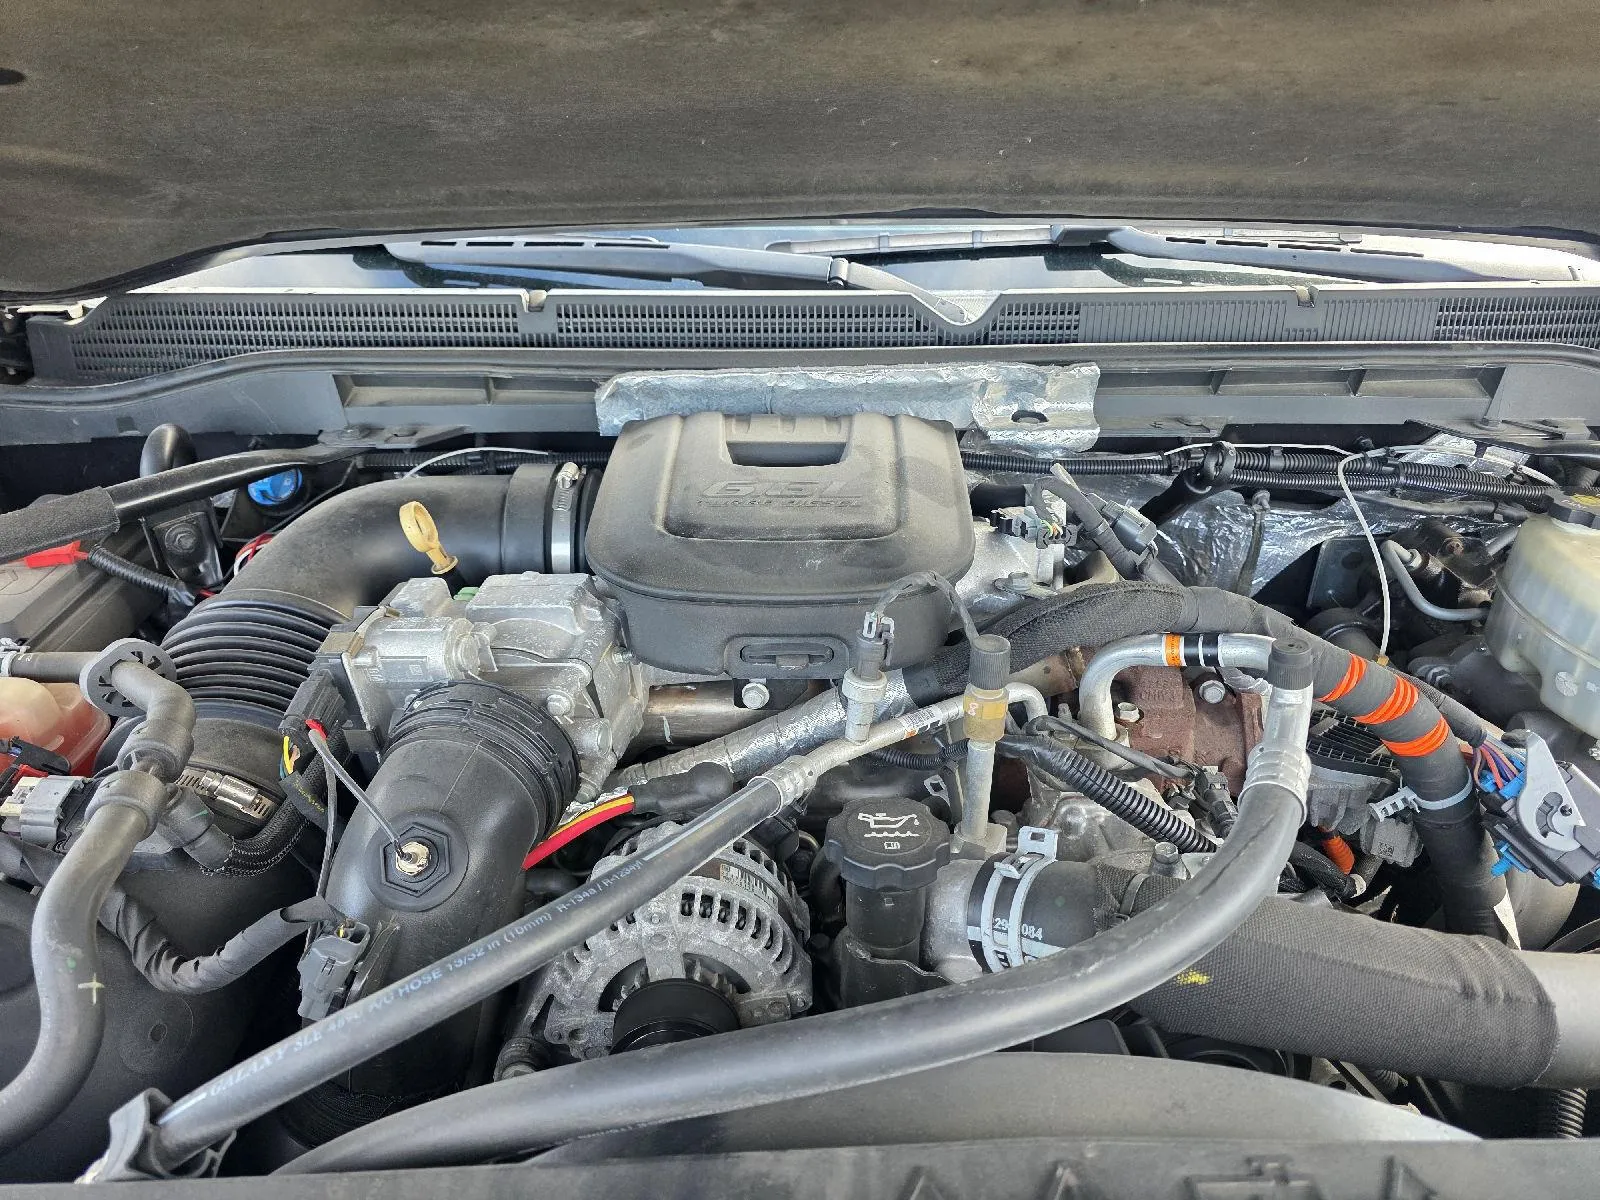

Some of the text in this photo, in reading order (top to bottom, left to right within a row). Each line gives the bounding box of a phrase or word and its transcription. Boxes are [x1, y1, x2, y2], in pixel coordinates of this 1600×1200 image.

[210, 1043, 289, 1097] GALAXY
[398, 967, 443, 998] HOSE
[487, 939, 501, 951] in
[503, 912, 553, 943] (10mm)
